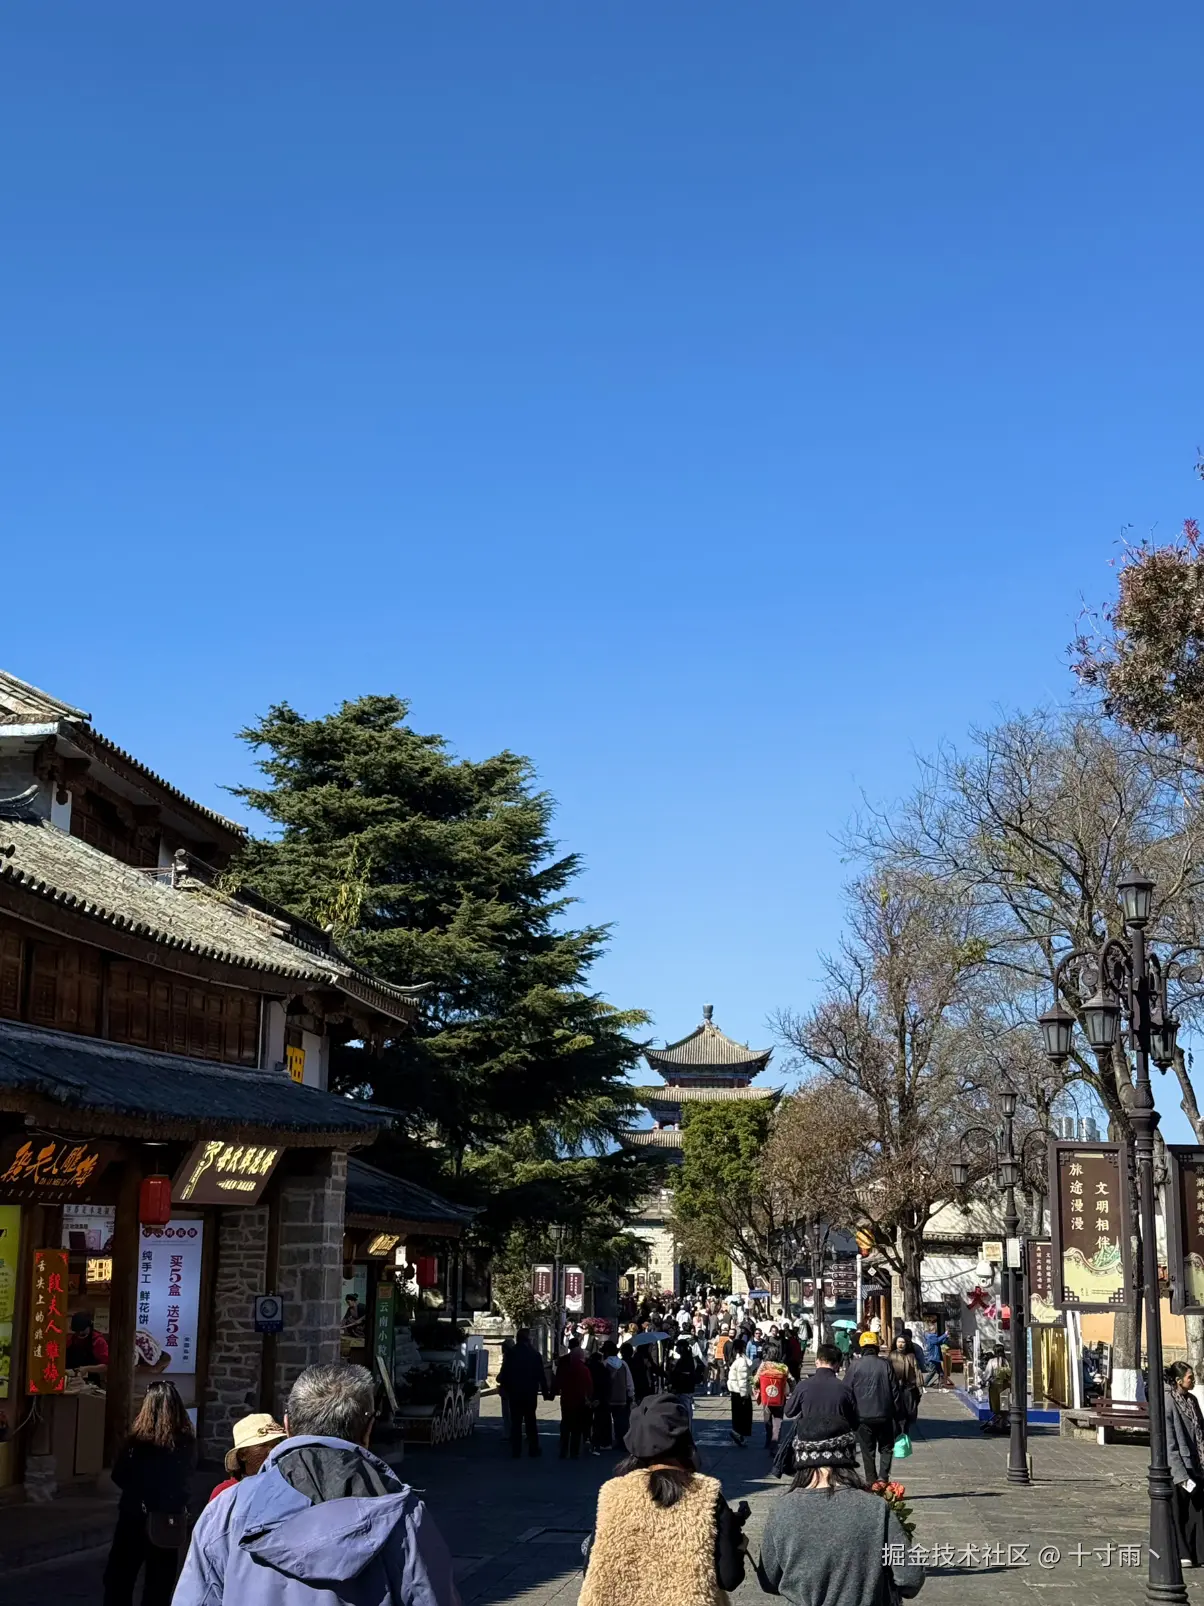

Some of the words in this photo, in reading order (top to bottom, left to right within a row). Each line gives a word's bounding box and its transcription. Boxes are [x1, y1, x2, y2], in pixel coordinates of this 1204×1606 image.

[1069, 1163, 1084, 1230] 旅途漫漫
[1095, 1182, 1110, 1250] 文明相伴
[141, 1251, 152, 1284] 纯手工
[168, 1255, 183, 1296] 买5盒
[139, 1290, 151, 1325] 鲜花饼
[165, 1305, 180, 1347] 送5盒
